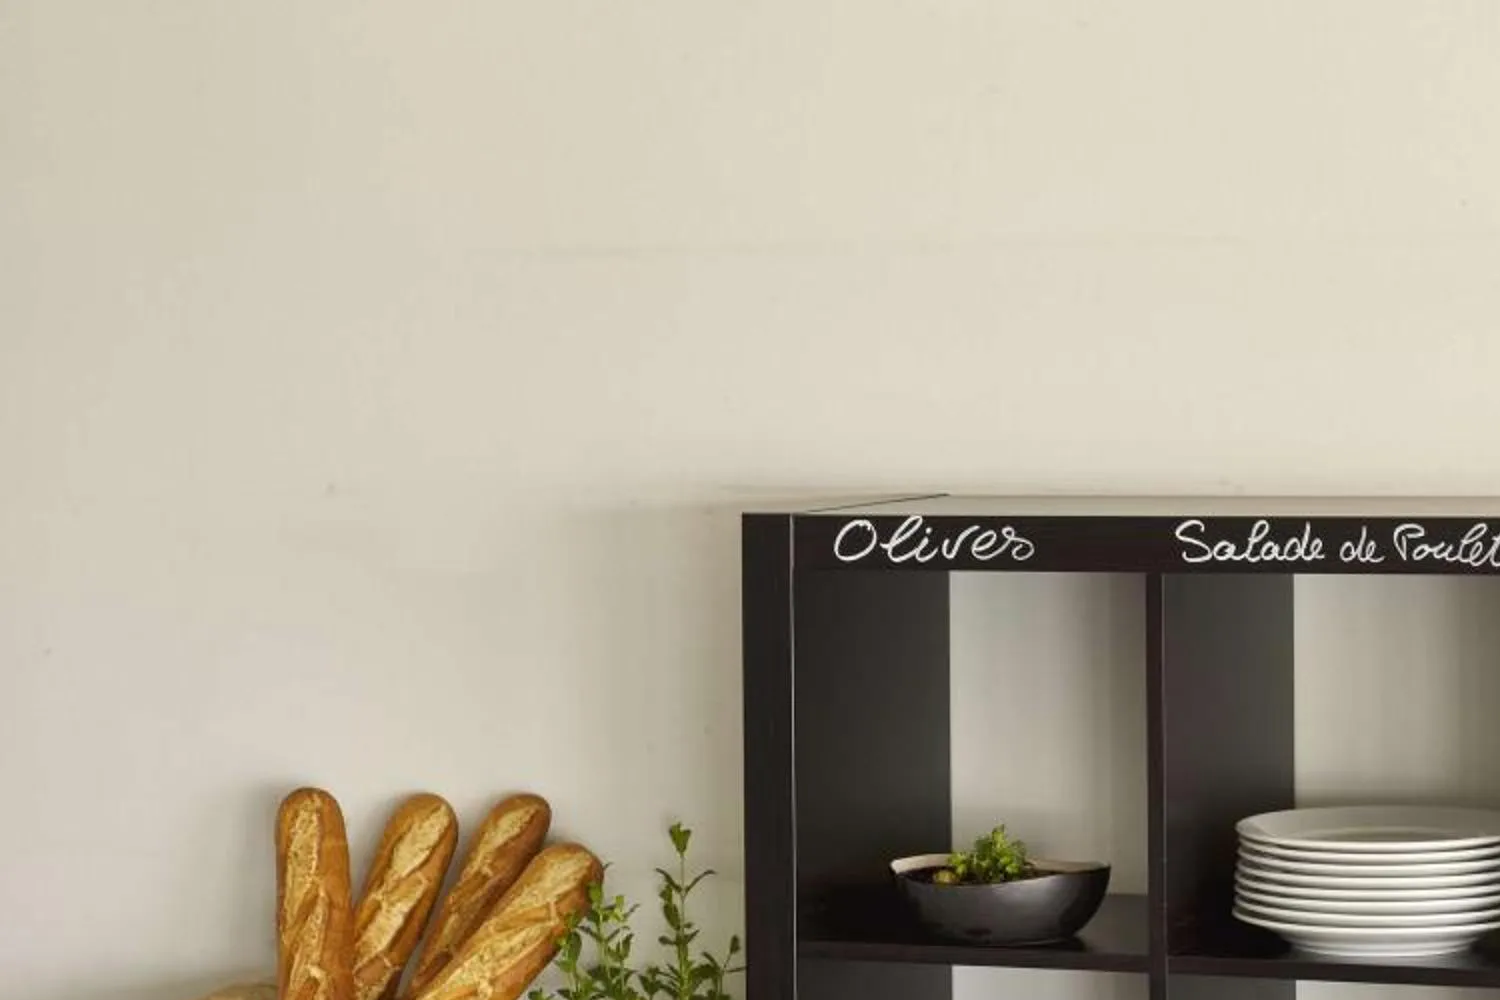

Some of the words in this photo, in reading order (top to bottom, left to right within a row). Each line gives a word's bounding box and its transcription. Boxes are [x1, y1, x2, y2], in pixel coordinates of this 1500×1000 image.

[833, 515, 1035, 563] Olives
[1174, 518, 1326, 564] Salade
[1338, 525, 1386, 563] de
